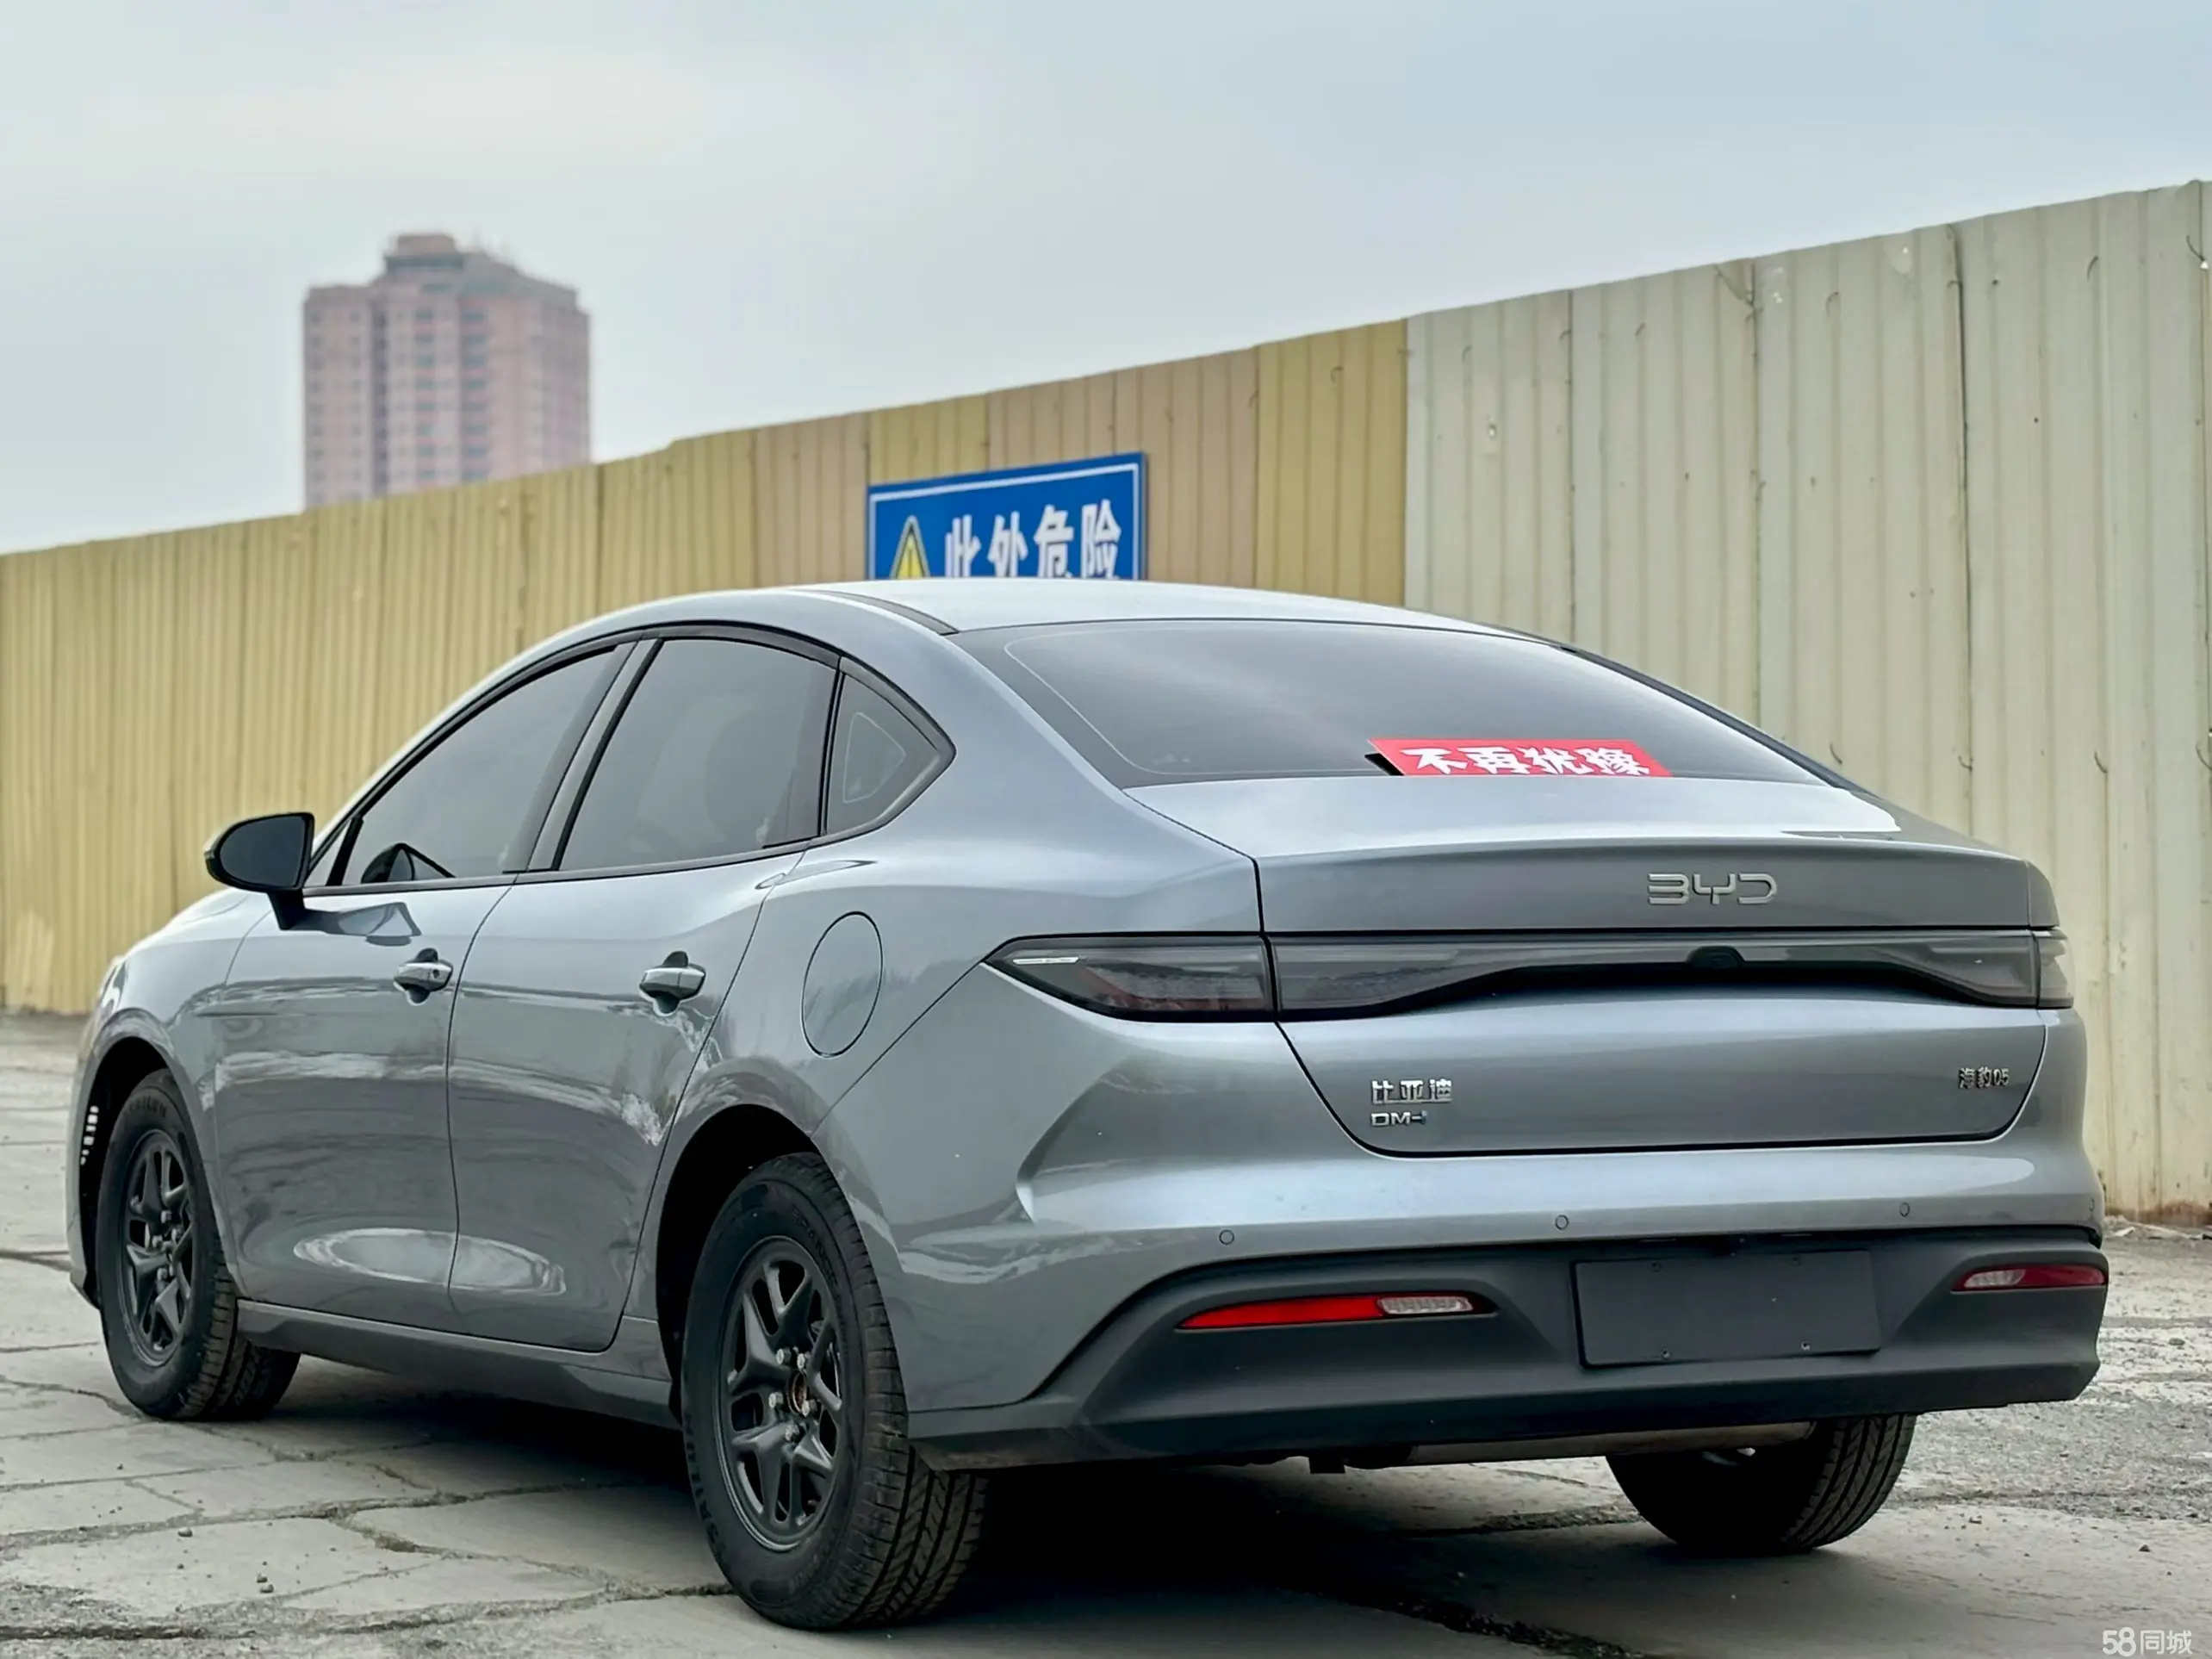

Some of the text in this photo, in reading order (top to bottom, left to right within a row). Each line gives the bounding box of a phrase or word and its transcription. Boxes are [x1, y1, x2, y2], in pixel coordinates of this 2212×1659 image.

[945, 499, 1122, 580] 此处危险
[1401, 747, 1650, 775] 不再犹豫
[1648, 873, 1777, 904] BYD
[1371, 1078, 1452, 1103] 比亚迪
